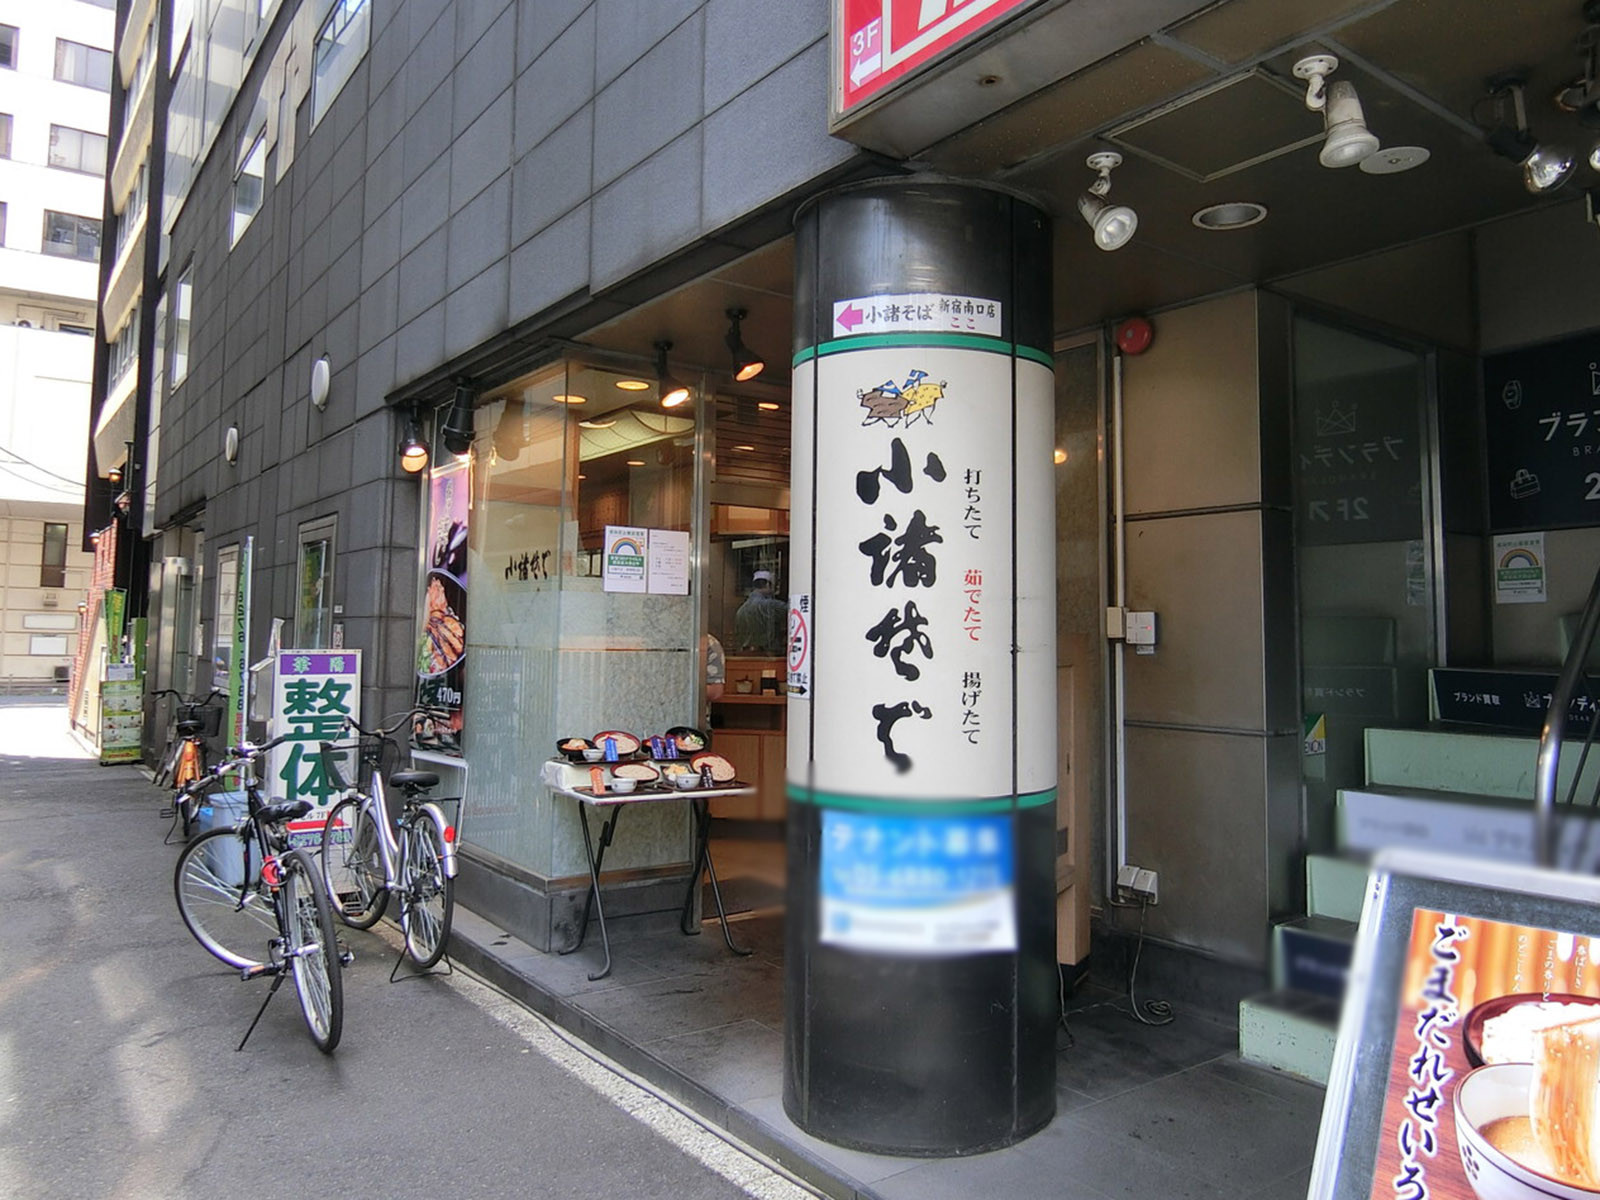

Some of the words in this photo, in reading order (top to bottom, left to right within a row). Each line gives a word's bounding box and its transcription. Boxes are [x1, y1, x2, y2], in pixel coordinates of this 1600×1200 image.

[852, 19, 880, 56] 3F
[865, 303, 934, 324] 小諸そば
[939, 298, 996, 319] 新宿南口店
[950, 317, 976, 330] ここ
[963, 468, 983, 540] 打ちたて
[963, 568, 983, 642] 茹でたて
[436, 687, 461, 704] 470円
[961, 671, 983, 745] 揚げたて
[280, 678, 352, 806] 整体
[1394, 922, 1468, 1200] ごまだれせいろ
